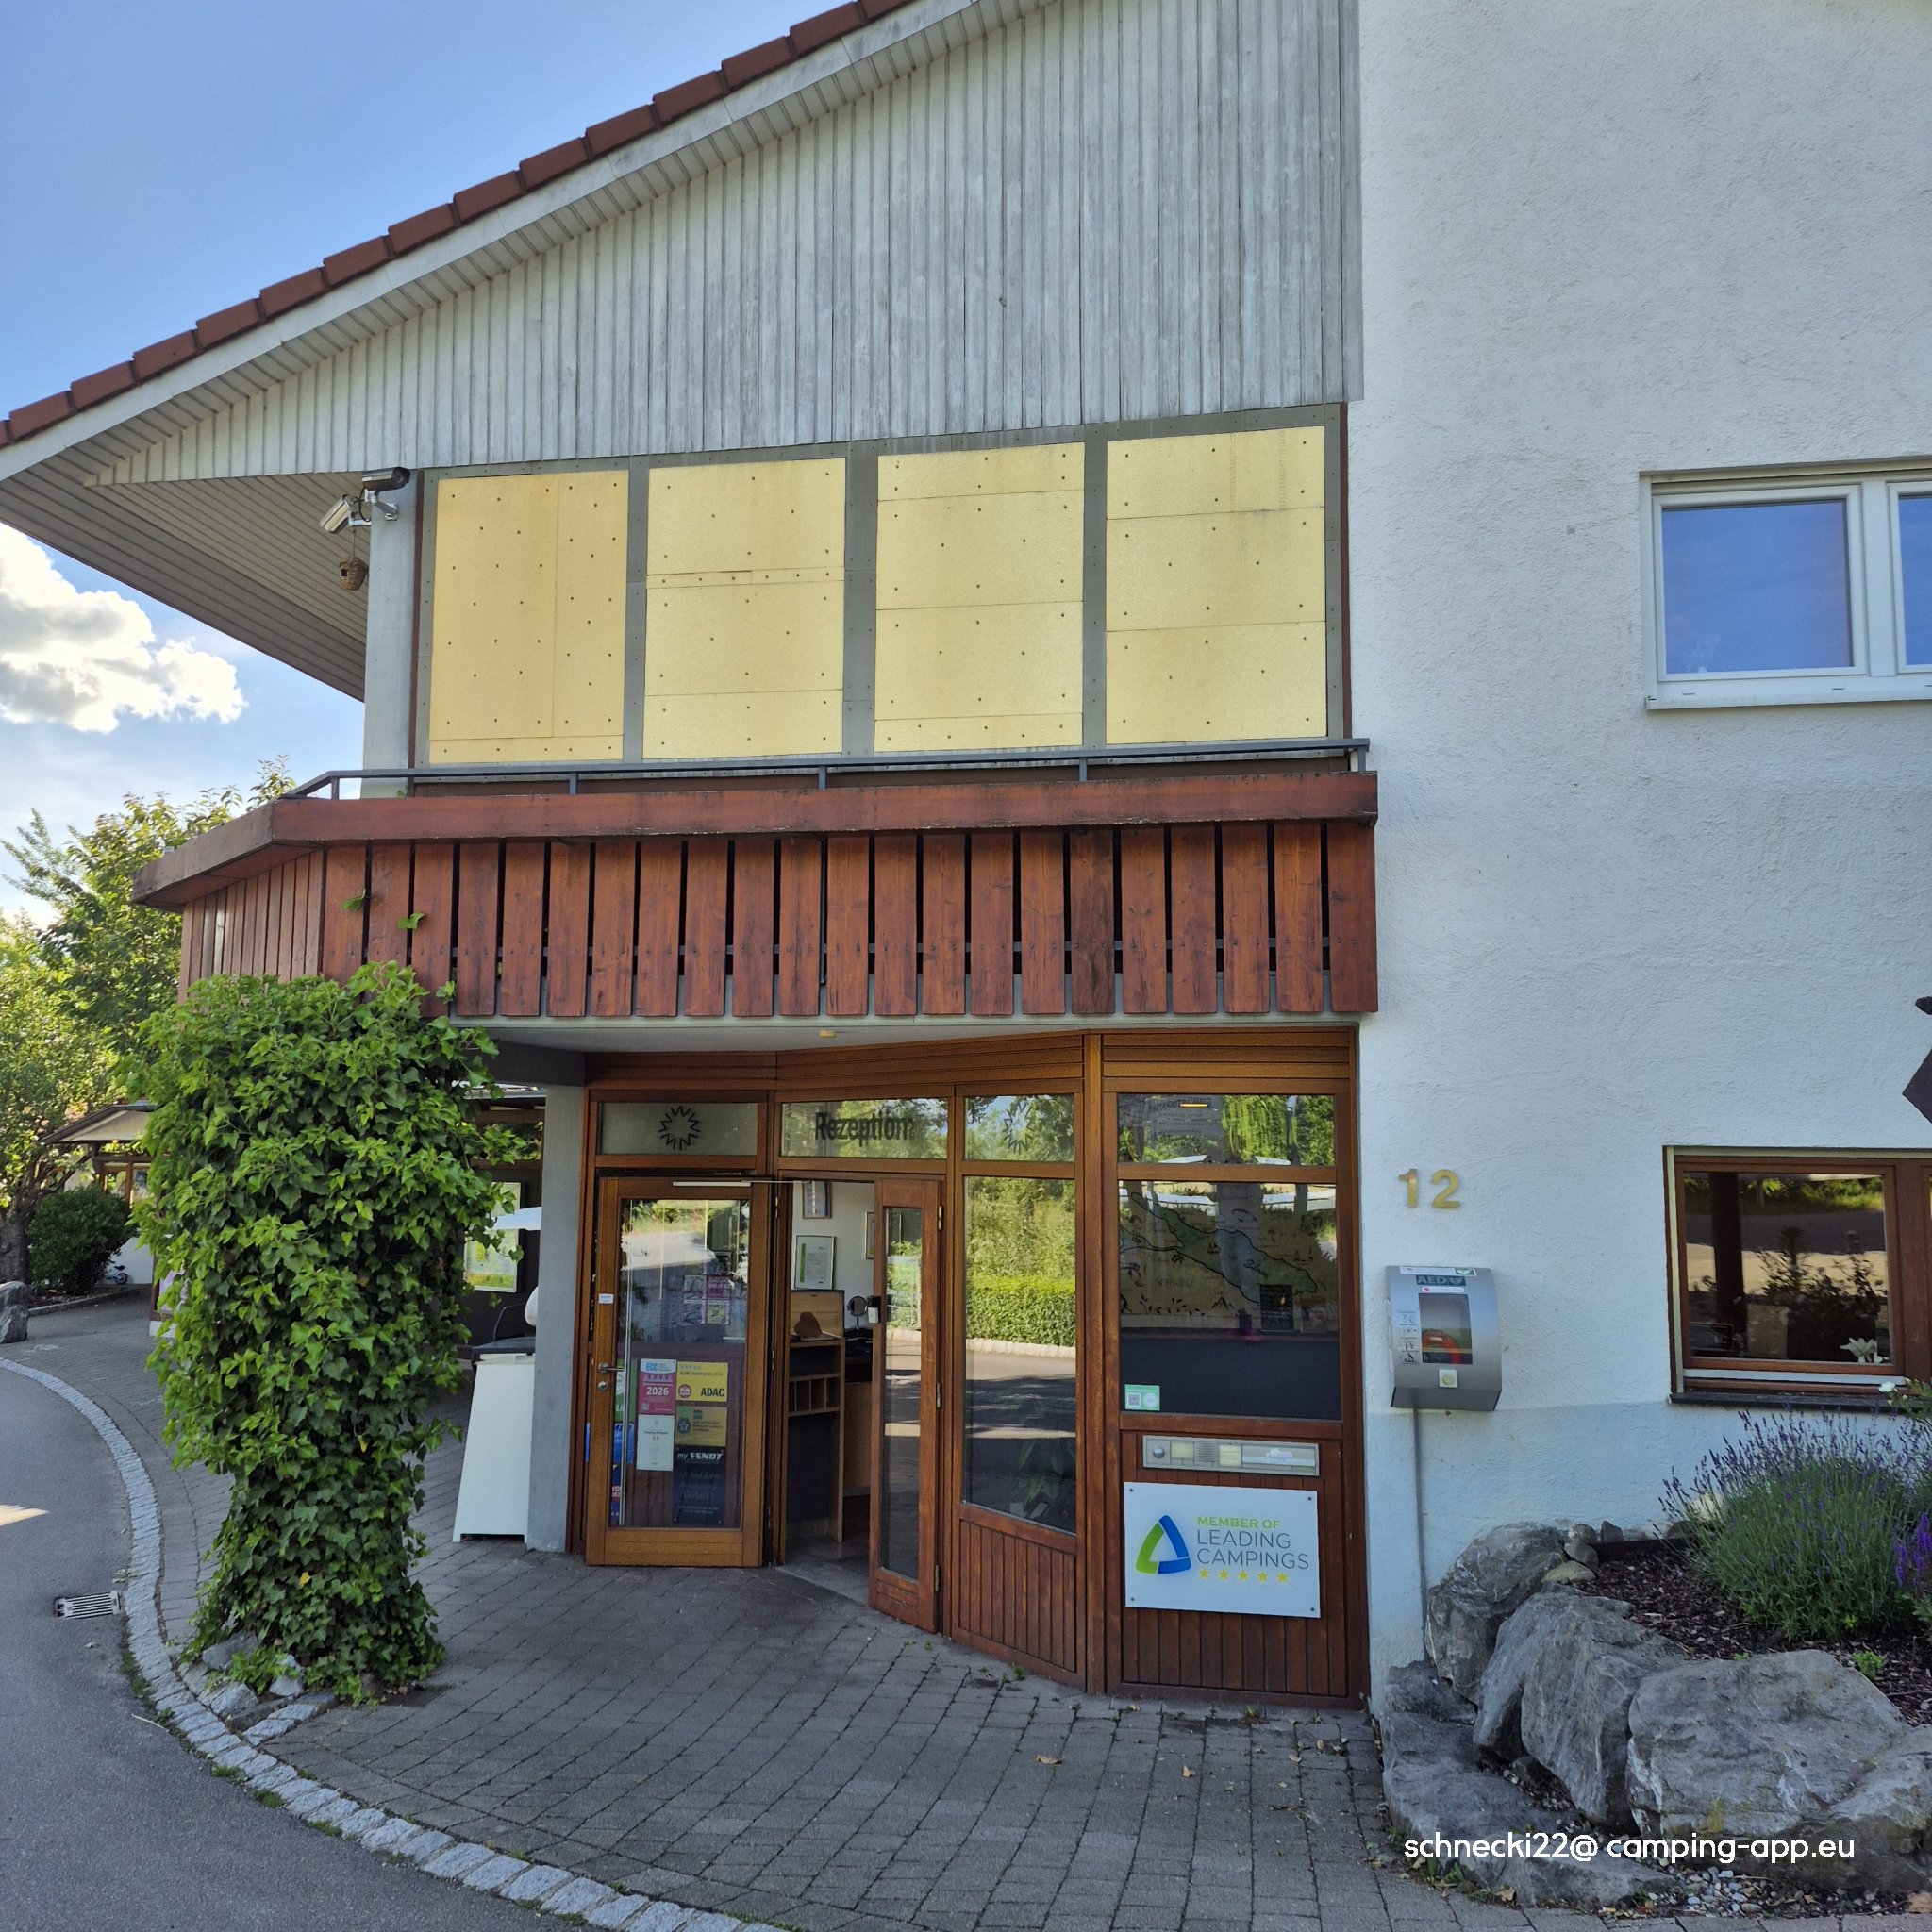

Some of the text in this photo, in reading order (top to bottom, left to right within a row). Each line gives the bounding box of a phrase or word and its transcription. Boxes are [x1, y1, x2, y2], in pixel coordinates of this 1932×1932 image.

[815, 1109, 908, 1147] Rezeption
[1398, 1168, 1460, 1208] 12
[1417, 1275, 1446, 1284] AED
[646, 1386, 669, 1395] 2026
[701, 1387, 724, 1397] ADAC
[690, 1452, 724, 1460] FENDT
[1197, 1516, 1281, 1529] MEMBER OF
[1197, 1529, 1291, 1549] LEADING
[1197, 1548, 1309, 1570] CAMPINGS
